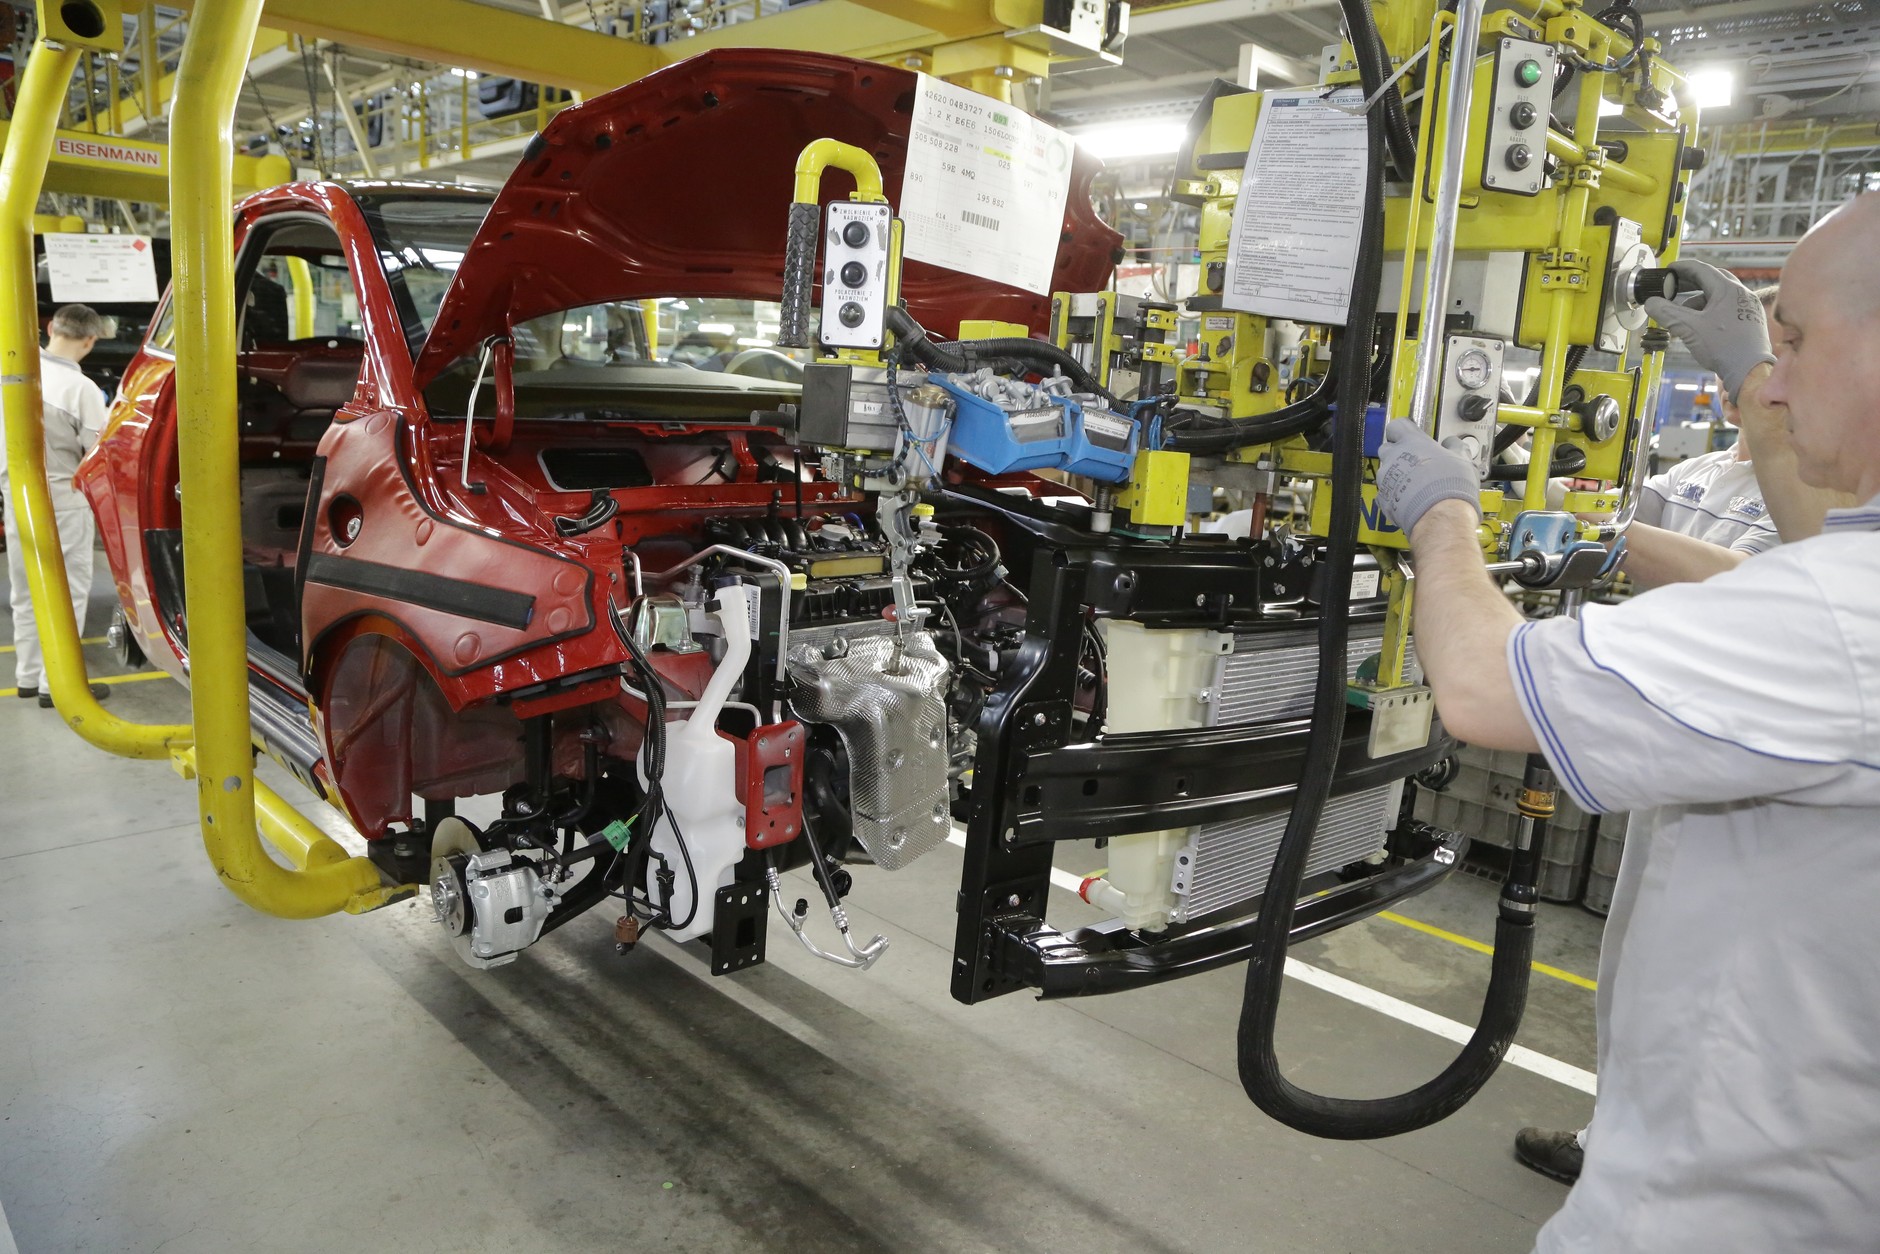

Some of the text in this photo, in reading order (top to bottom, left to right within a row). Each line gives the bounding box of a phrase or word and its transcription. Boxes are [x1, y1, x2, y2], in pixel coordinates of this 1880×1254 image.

[925, 90, 947, 104] 42620
[950, 98, 983, 115] 0483727
[928, 107, 942, 119] 1.2
[955, 116, 977, 130] E6E6
[915, 132, 928, 143] 505
[930, 137, 943, 148] 508
[944, 142, 959, 153] 228
[60, 140, 159, 165] EISENMANN
[942, 162, 956, 173] 59E
[998, 159, 1011, 170] 025
[910, 171, 923, 183] 890
[977, 192, 990, 204] 195
